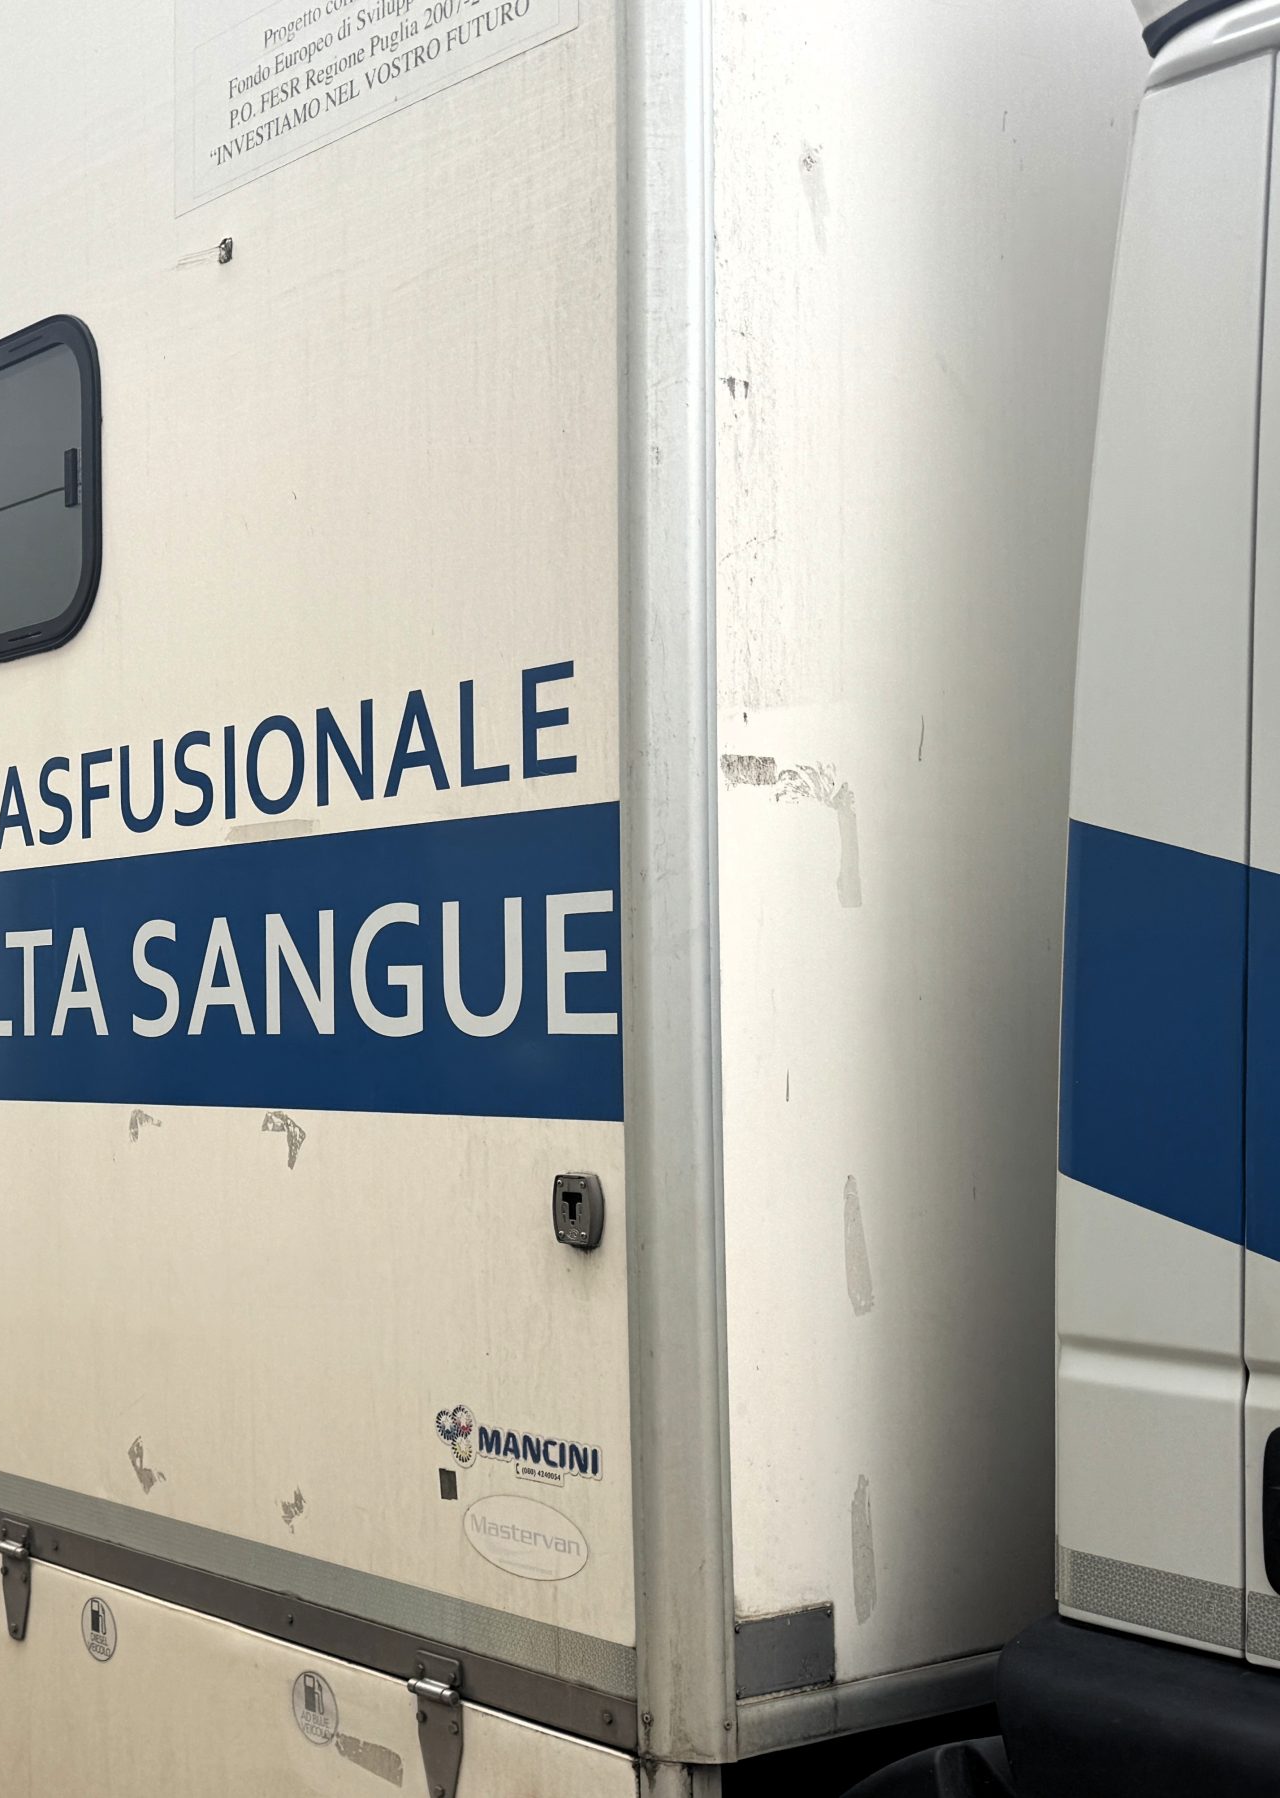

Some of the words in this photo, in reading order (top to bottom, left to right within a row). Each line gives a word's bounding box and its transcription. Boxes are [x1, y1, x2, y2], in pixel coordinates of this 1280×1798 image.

[229, 64, 271, 99] Fondo
[274, 33, 333, 75] Europeo
[337, 16, 351, 42] di
[230, 102, 256, 129] P.O.
[260, 77, 302, 114] FESR
[305, 47, 365, 90] Regione
[369, 20, 419, 57] Puglia
[423, 0, 480, 30] 2007-
[263, 7, 321, 48] Progetto
[325, 79, 360, 112] NEL
[364, 37, 440, 91] VOSTRO
[447, 0, 531, 52] FUTURO
[132, 889, 619, 1038] SANGUE
[478, 1426, 599, 1476] MANCINI
[470, 1513, 581, 1557] Mastervan
